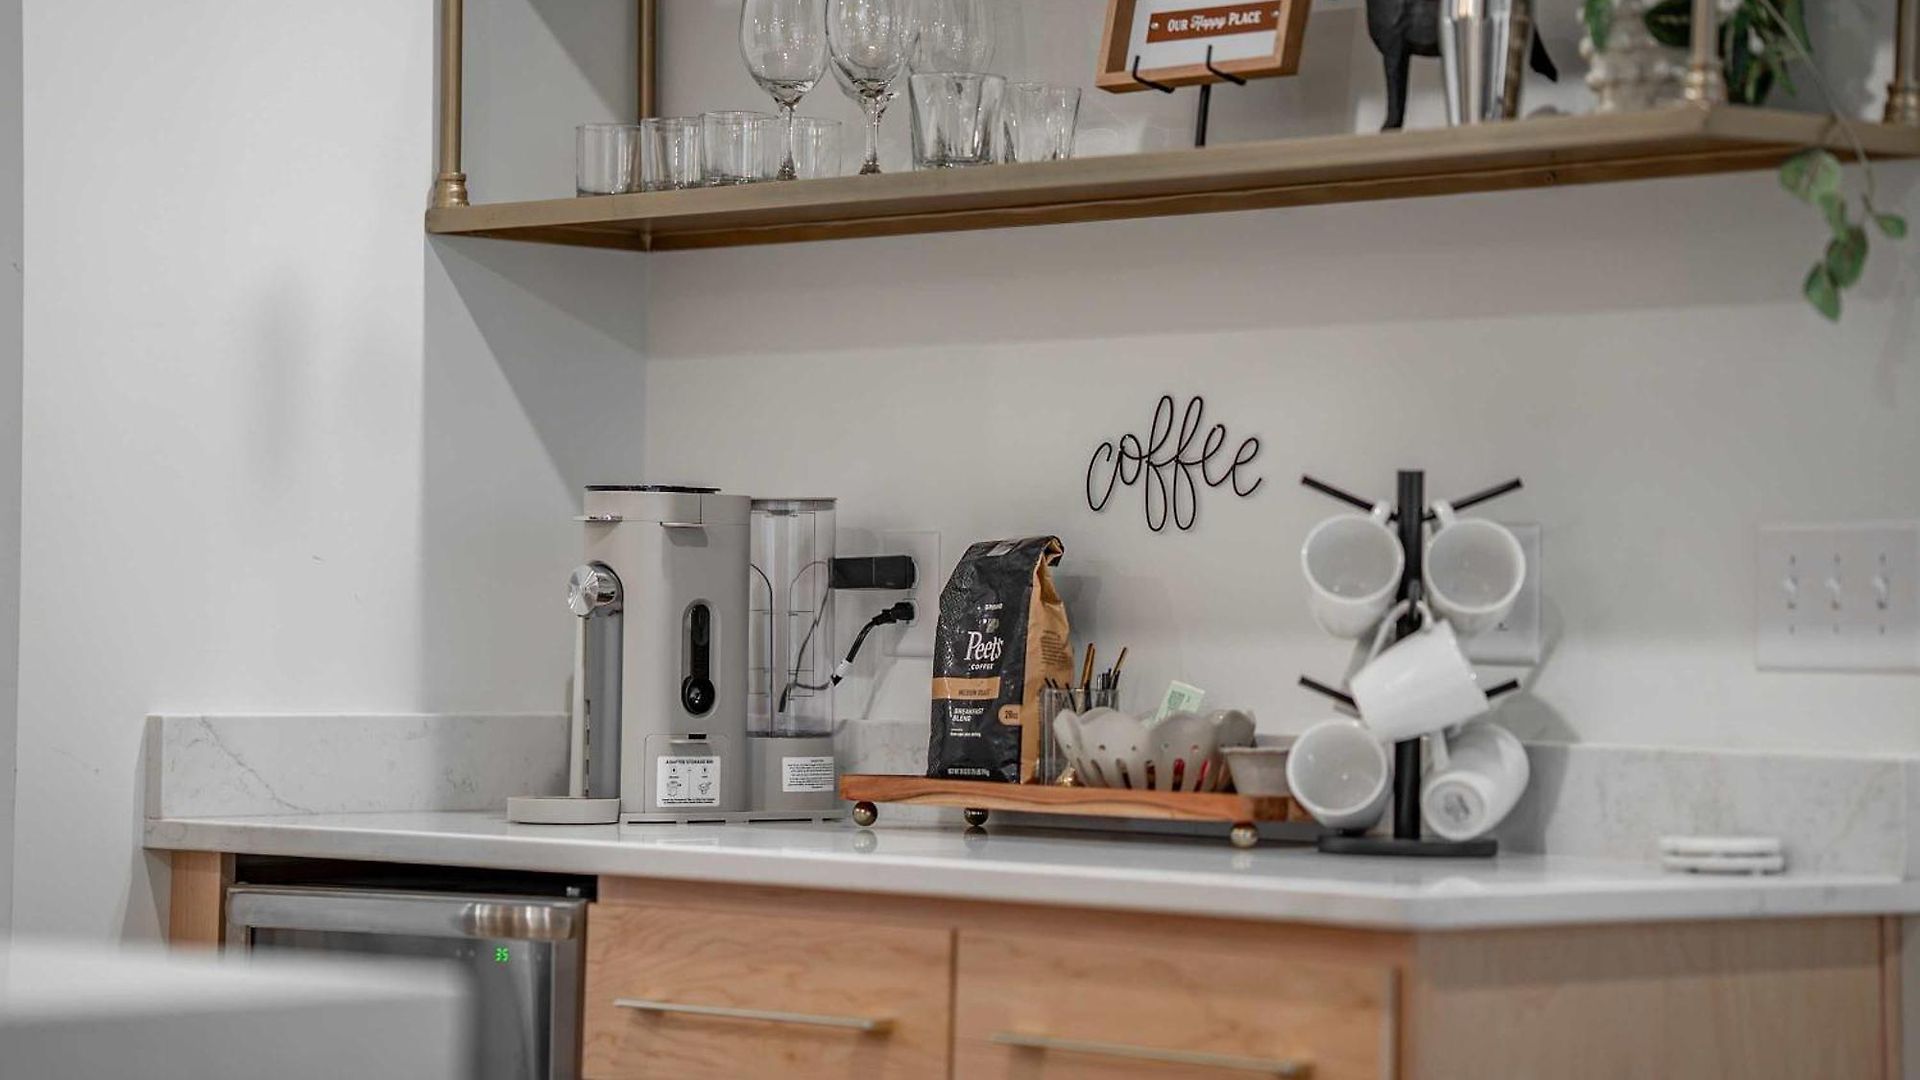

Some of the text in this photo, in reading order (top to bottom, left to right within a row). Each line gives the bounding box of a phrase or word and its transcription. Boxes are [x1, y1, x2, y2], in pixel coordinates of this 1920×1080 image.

[1167, 11, 1262, 32] OUR Happy PLACE
[1087, 395, 1262, 532] coffee
[951, 714, 972, 722] BLEND
[953, 707, 984, 715] BREAKFAST
[495, 947, 509, 962] 35
